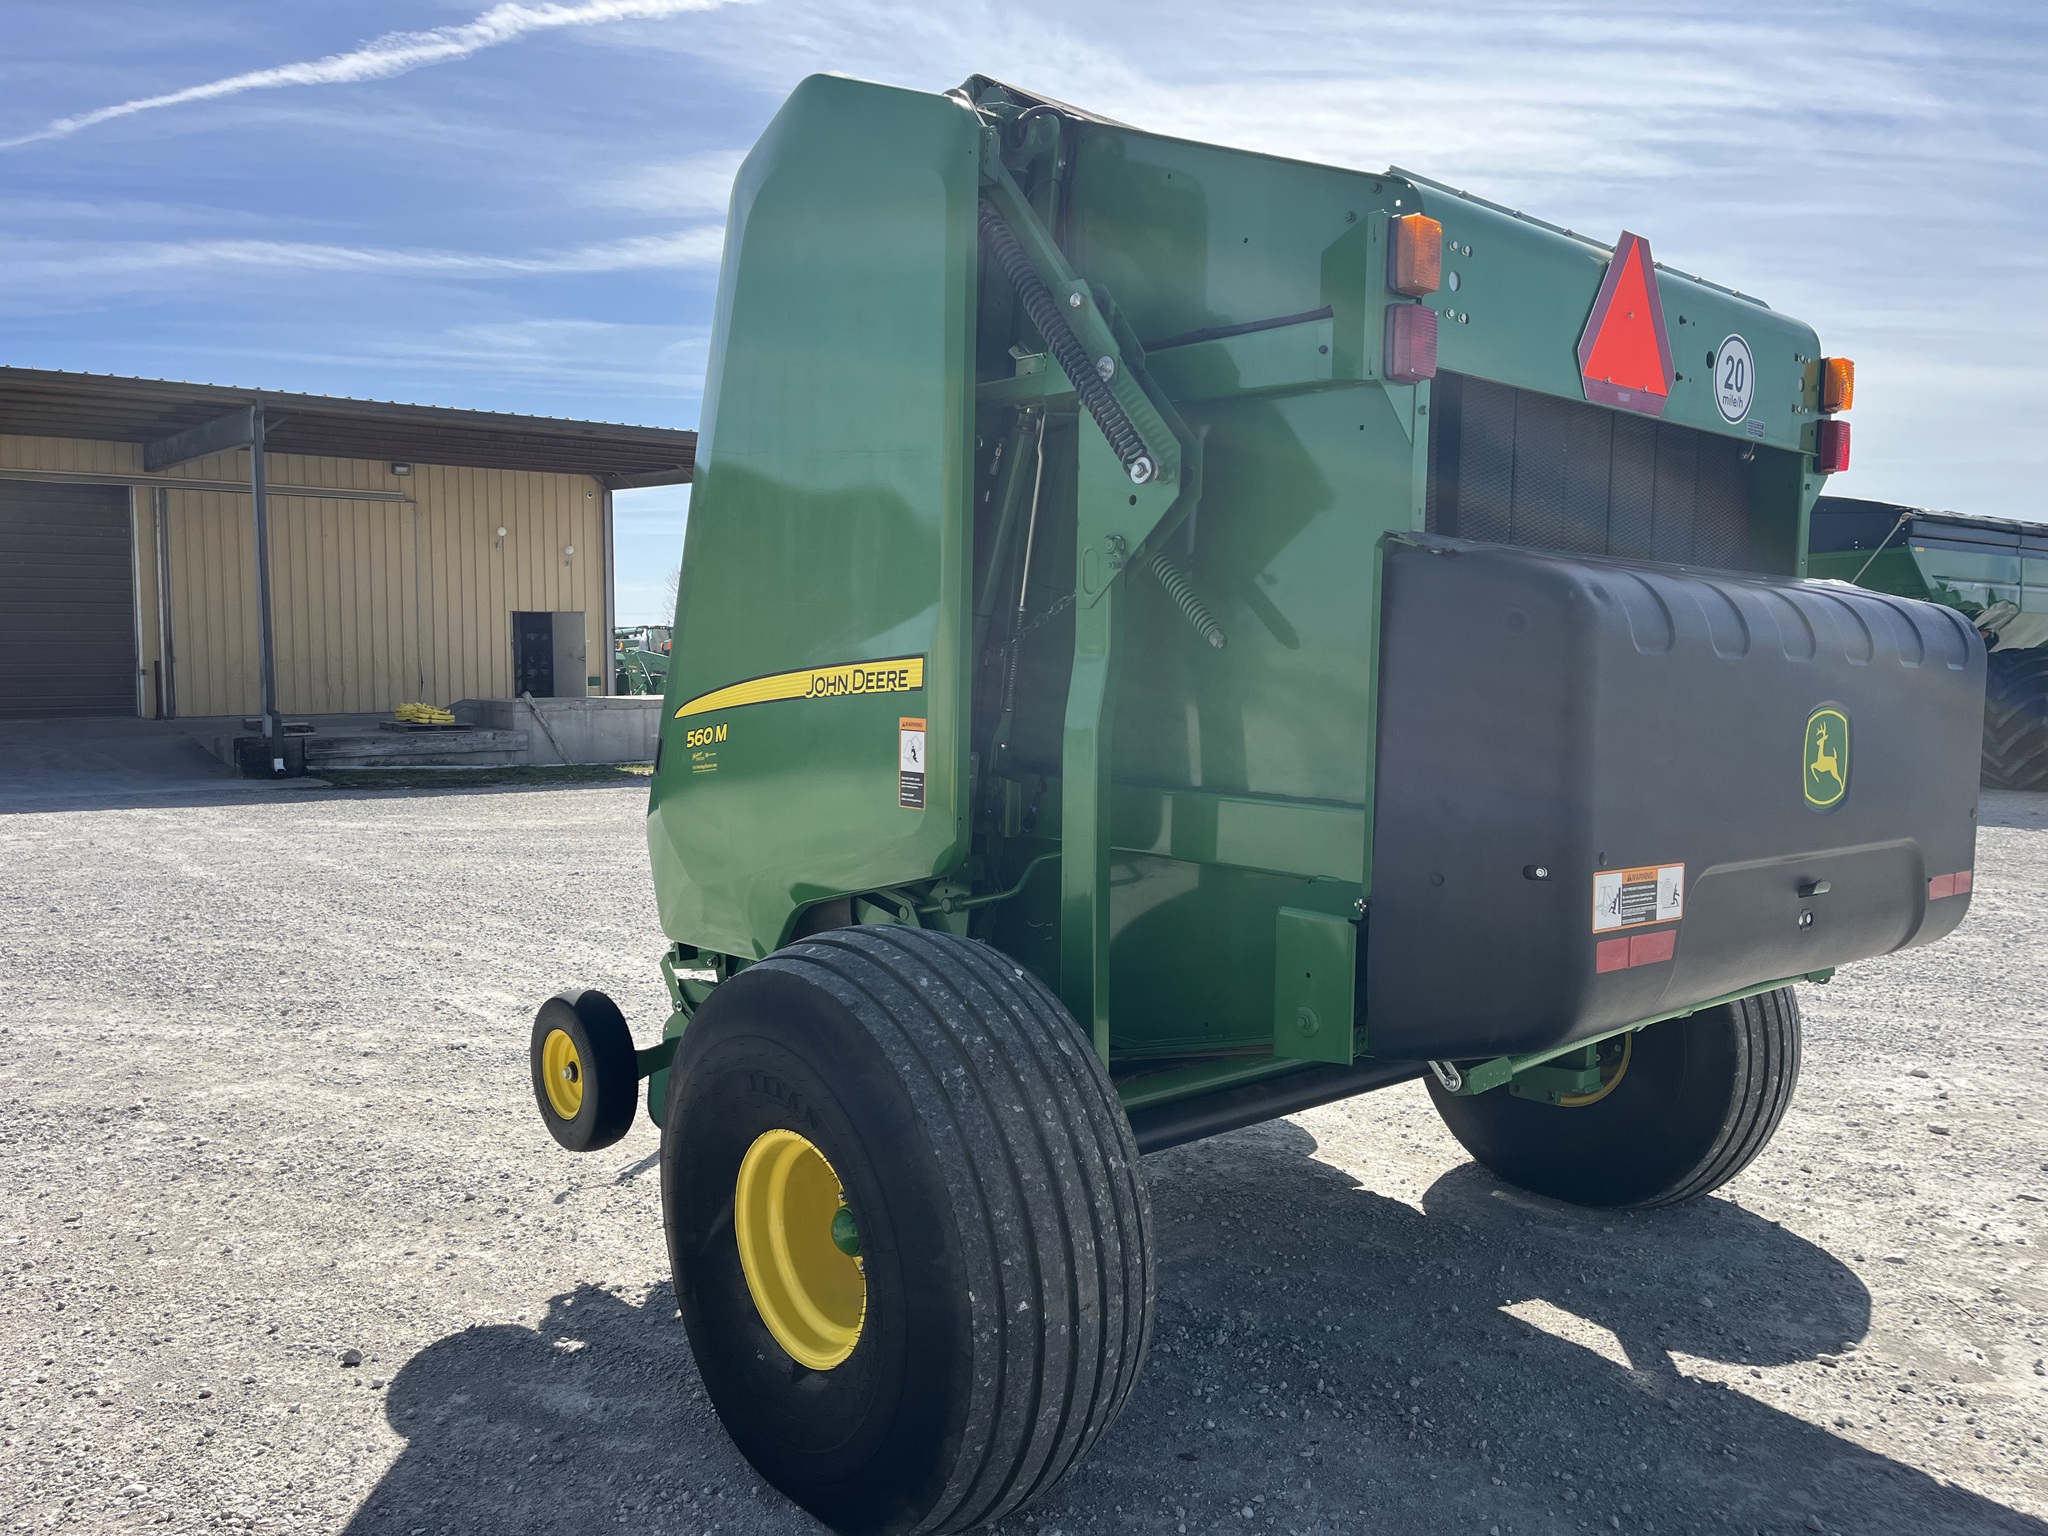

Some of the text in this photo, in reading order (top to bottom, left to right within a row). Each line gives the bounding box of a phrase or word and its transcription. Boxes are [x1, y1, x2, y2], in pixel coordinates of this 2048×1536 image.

[1724, 355, 1744, 393] 20
[805, 668, 909, 696] JOHN DEERE
[686, 722, 728, 749] 560 M
[1632, 872, 1654, 881] WARNING
